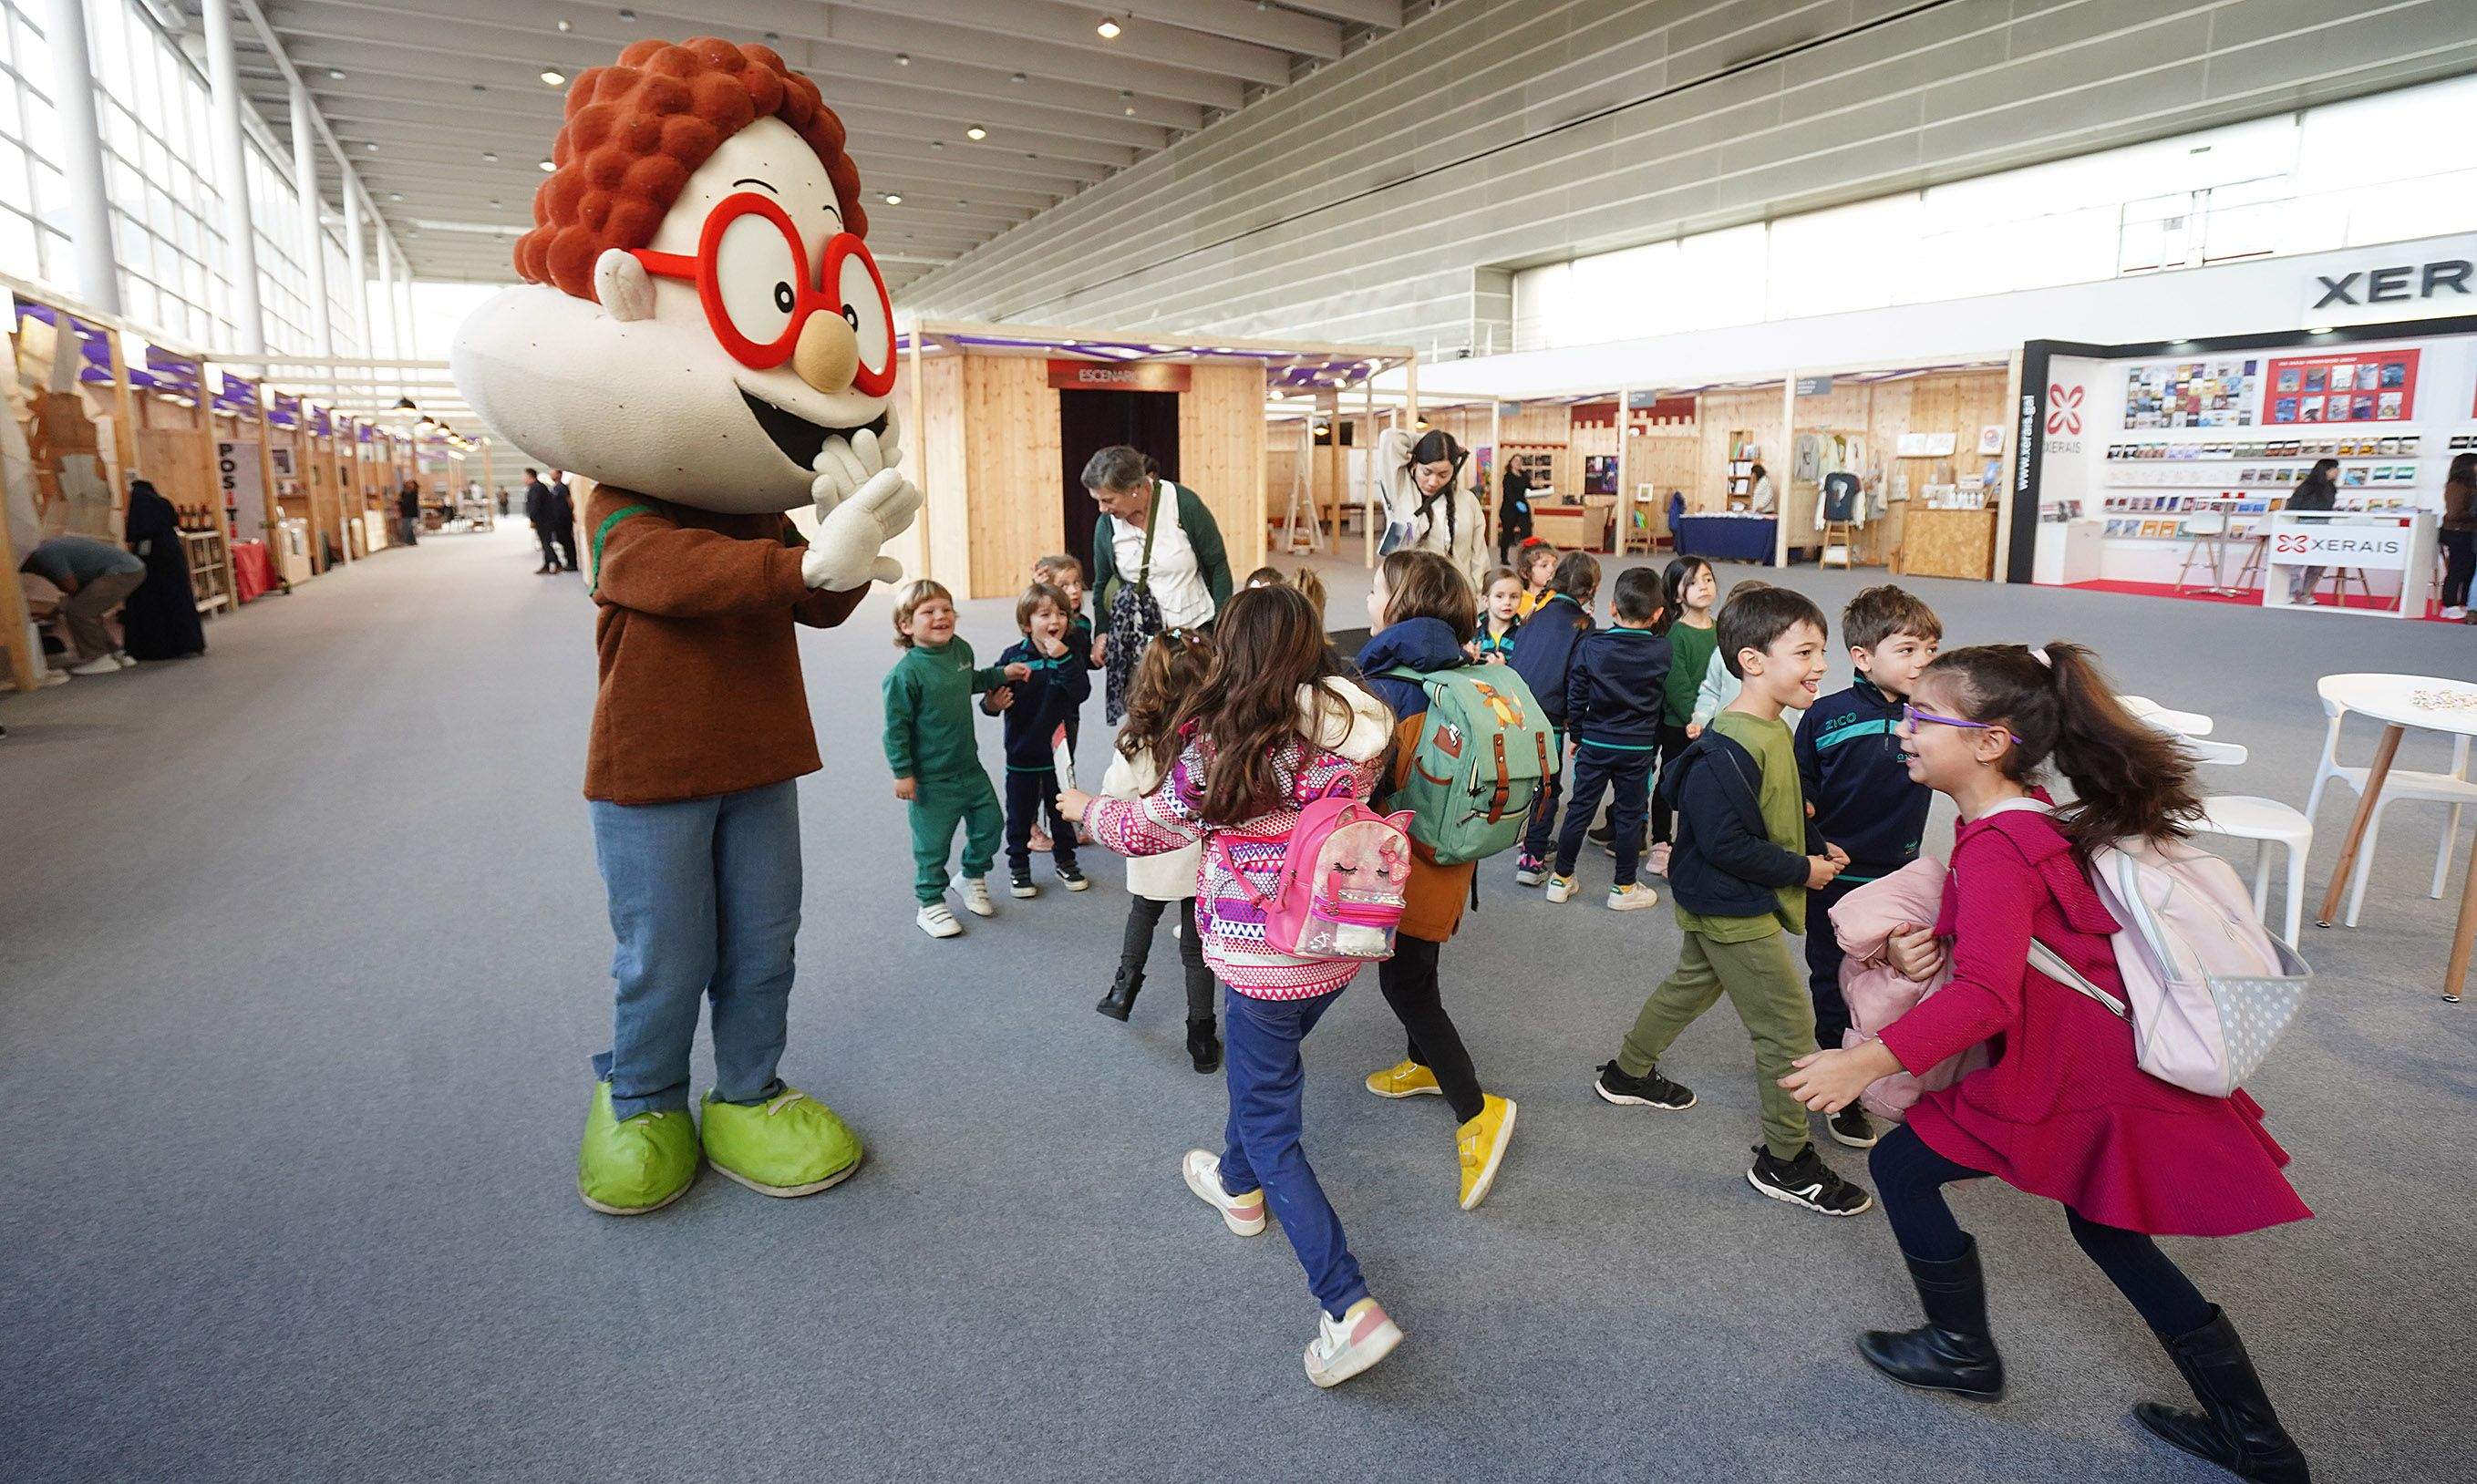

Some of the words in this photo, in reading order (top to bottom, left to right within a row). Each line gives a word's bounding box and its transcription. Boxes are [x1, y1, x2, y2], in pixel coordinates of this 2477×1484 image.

[2312, 260, 2473, 309] XER
[2018, 395, 2036, 491] www.xerais.gal
[2045, 440, 2082, 454] XERAIS
[2311, 539, 2400, 554] XERAIS
[1825, 712, 1857, 731] ZICO
